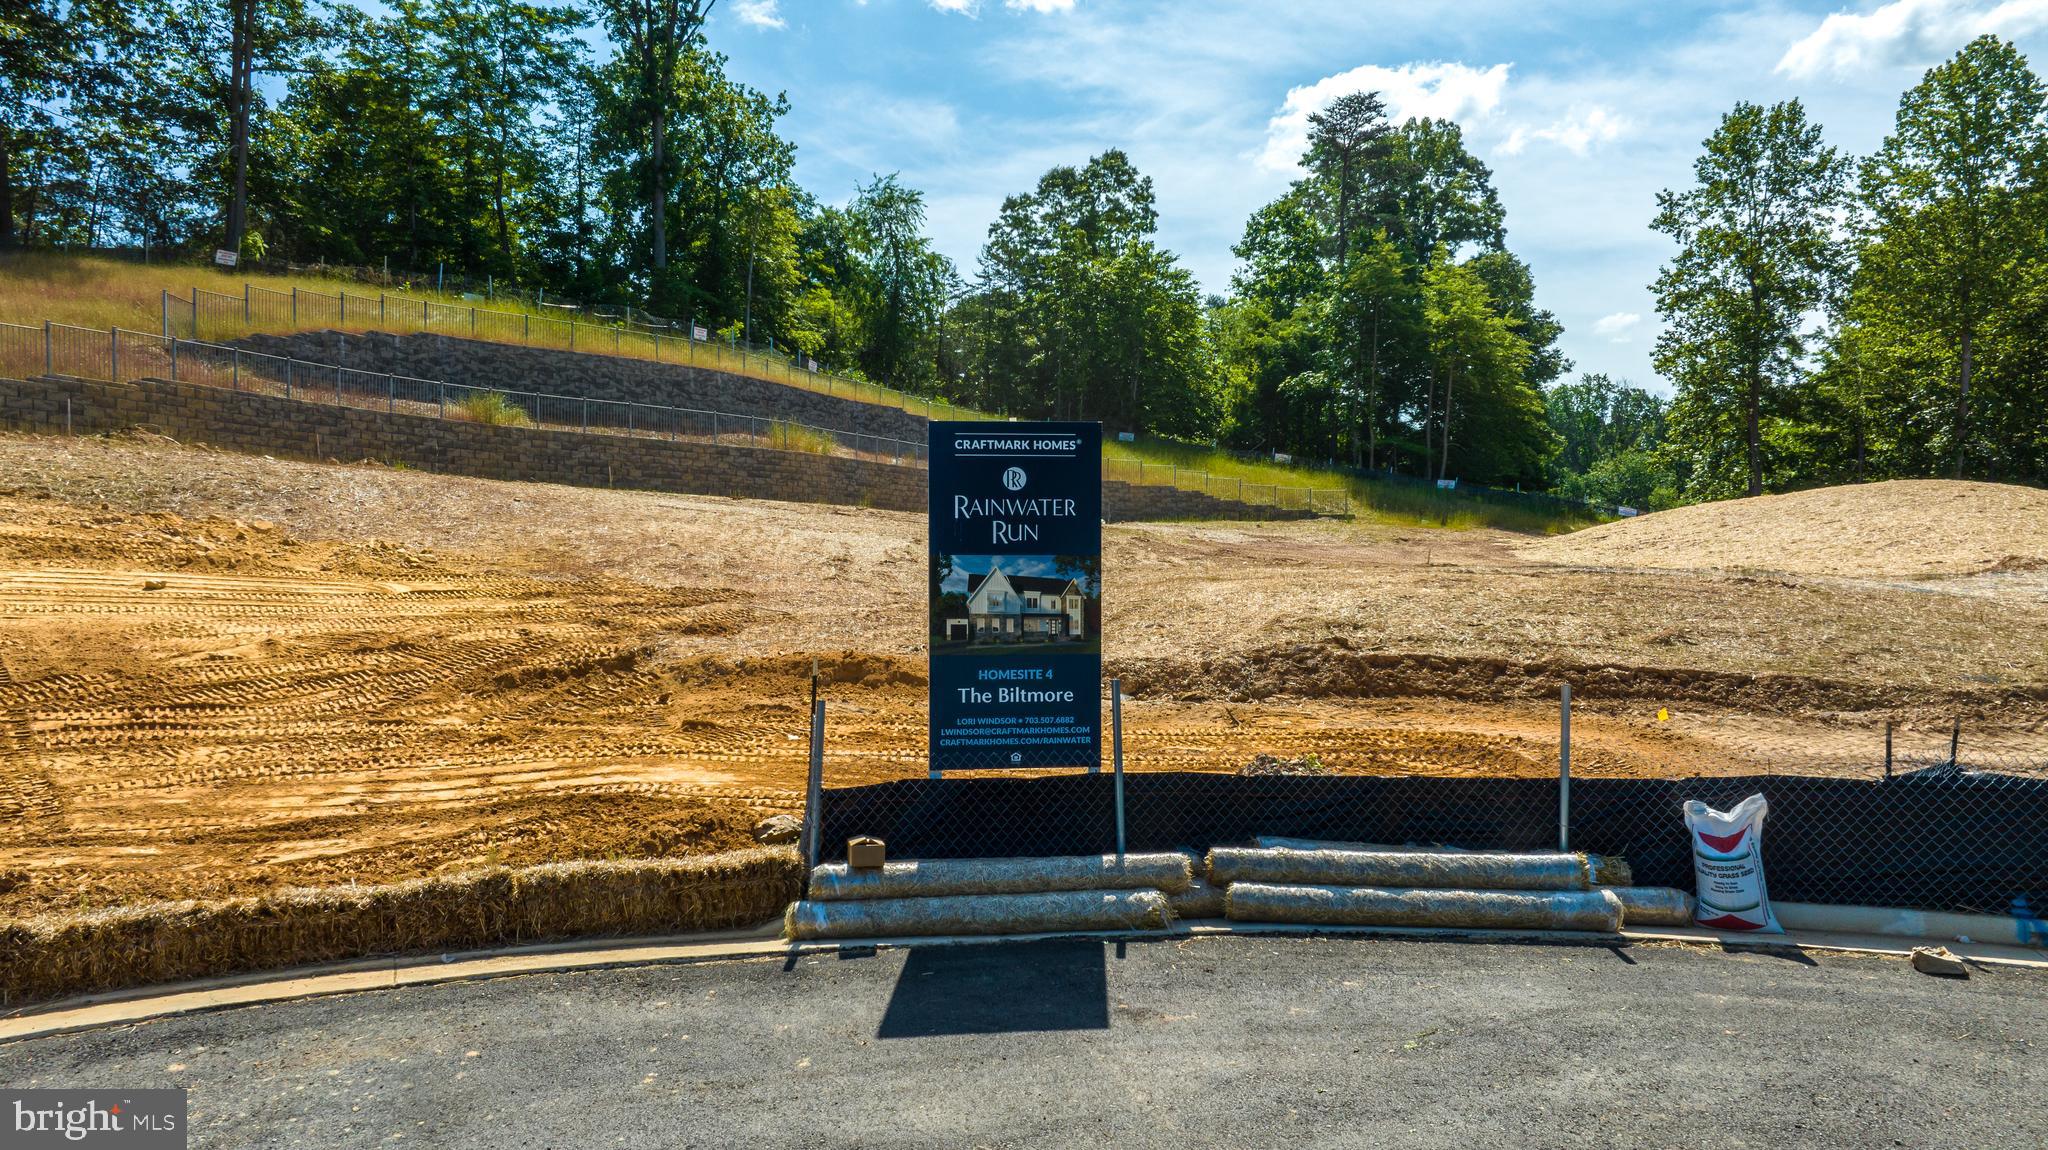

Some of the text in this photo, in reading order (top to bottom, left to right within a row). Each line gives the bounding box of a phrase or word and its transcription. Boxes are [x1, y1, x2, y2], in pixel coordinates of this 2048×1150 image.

[954, 439, 1030, 450] CRAFTMARK
[954, 495, 1077, 519] RAINWATER
[992, 520, 1039, 544] RUN
[978, 669, 1053, 680] HOMESITE 4
[957, 686, 1074, 703] The Biltmore
[957, 717, 976, 726] LORI
[977, 717, 1017, 725] WINDSOR
[940, 726, 1090, 736] LWINDSOR@CRAFTMARKHOMES.COM
[939, 736, 1092, 746] CRAFTMARKHOMES.COM/RAINWATER
[1701, 862, 1746, 872] PROFESSIONAL
